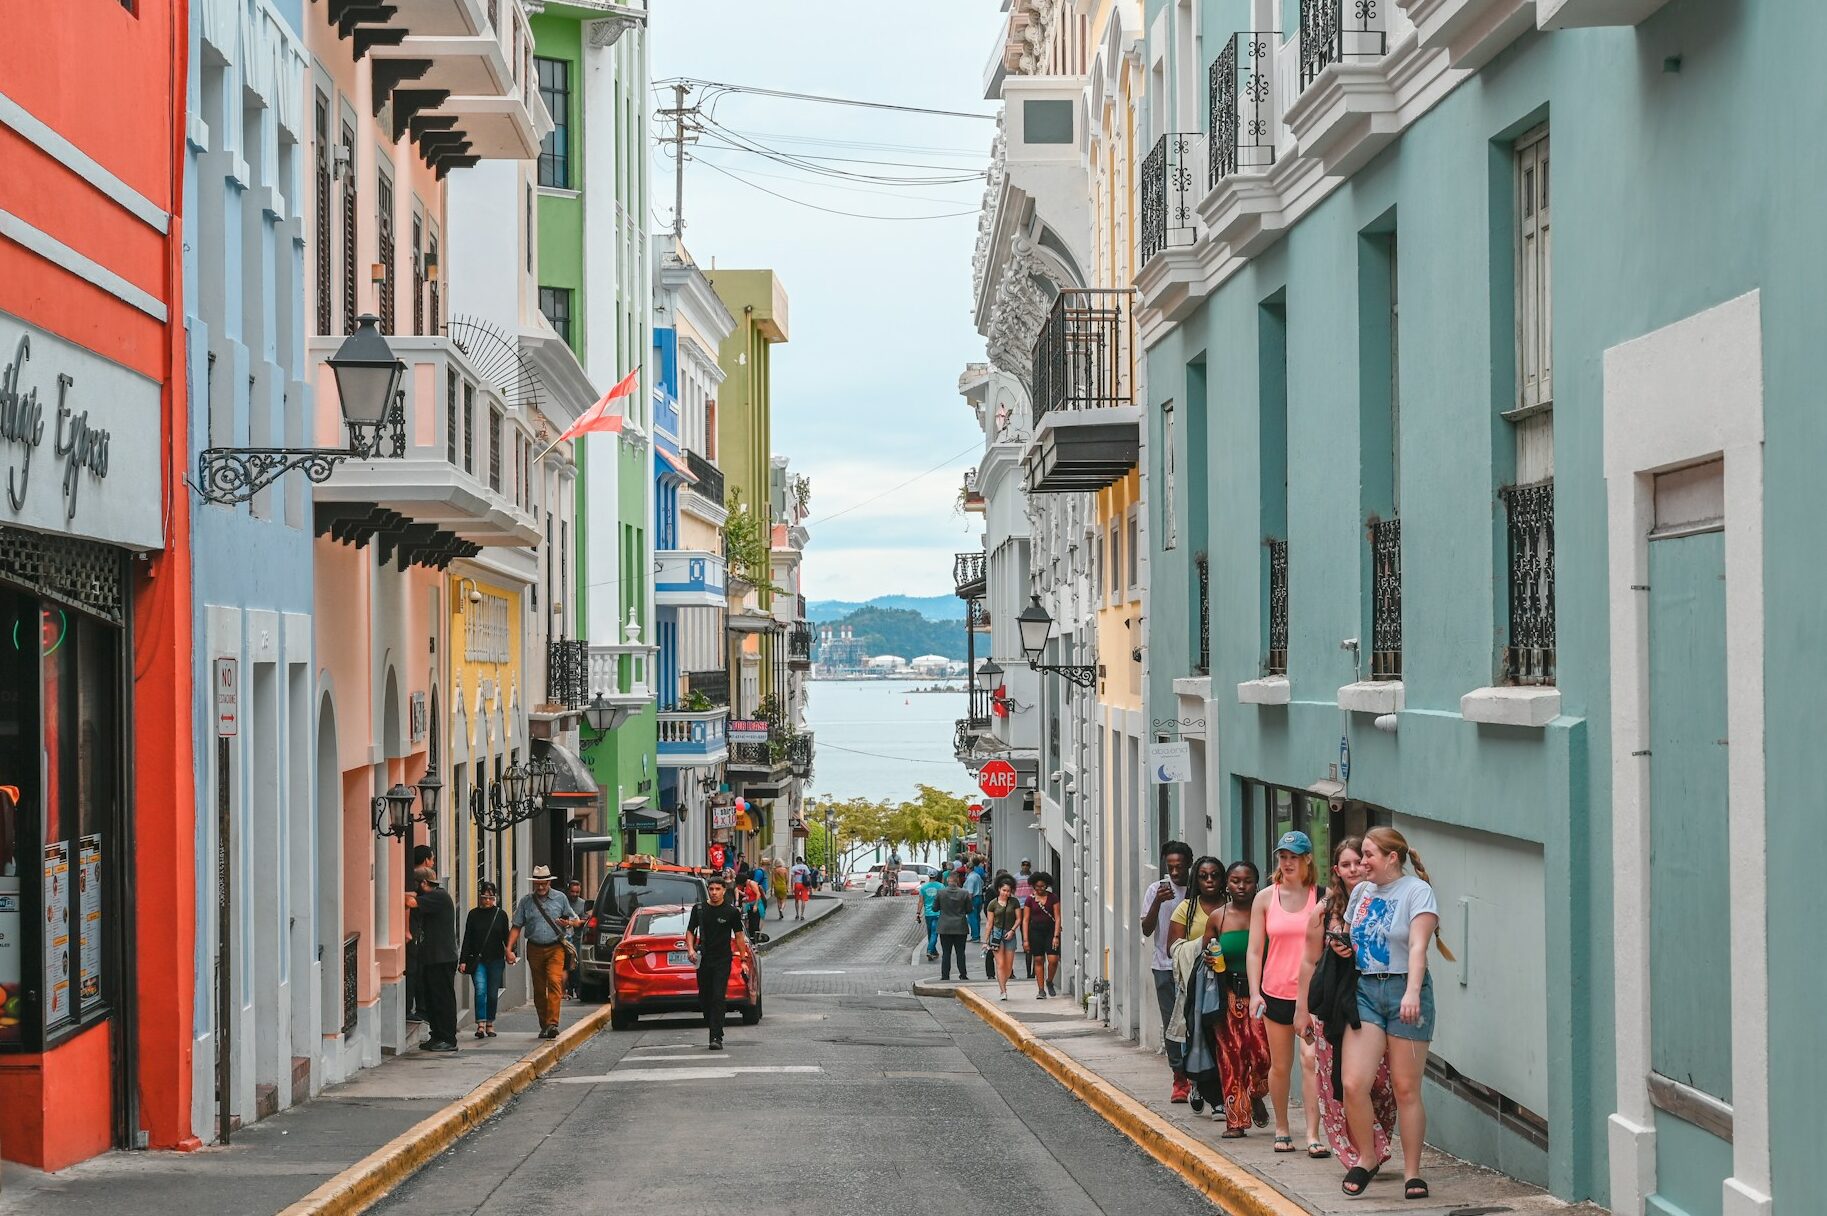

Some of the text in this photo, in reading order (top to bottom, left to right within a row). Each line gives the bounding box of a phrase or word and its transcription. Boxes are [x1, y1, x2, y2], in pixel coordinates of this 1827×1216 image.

[222, 668, 232, 688] NO
[732, 720, 768, 731] FOR LEASE
[980, 771, 1015, 787] PARE
[713, 815, 719, 825] 4
[728, 812, 738, 824] 10
[967, 809, 981, 817] PAR
